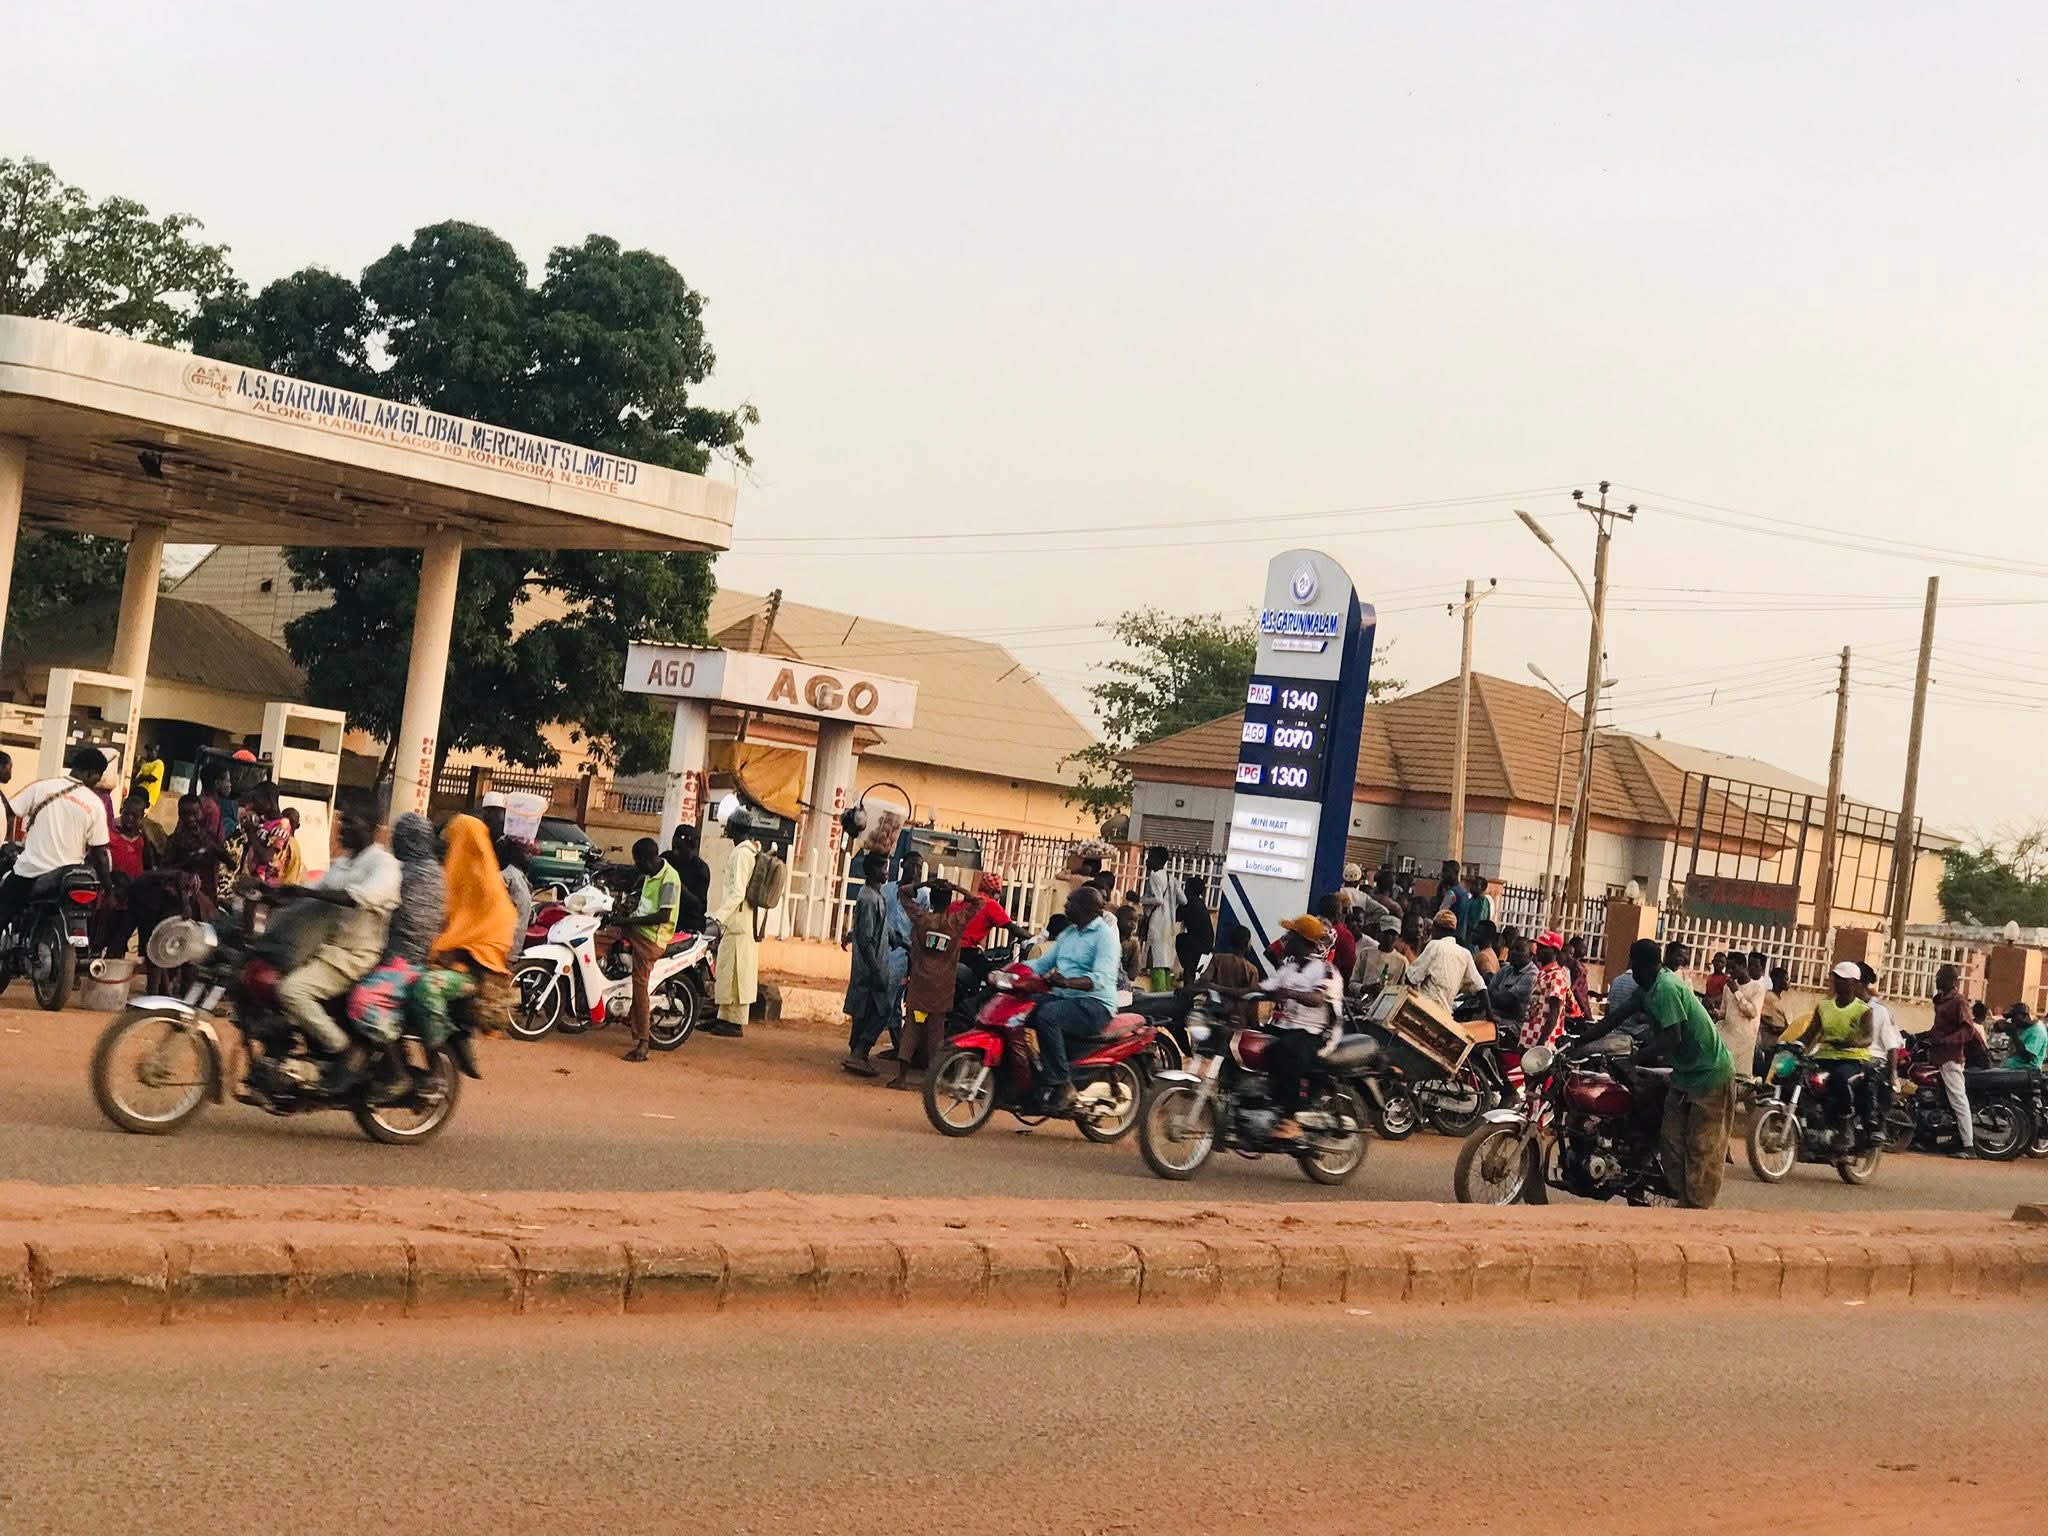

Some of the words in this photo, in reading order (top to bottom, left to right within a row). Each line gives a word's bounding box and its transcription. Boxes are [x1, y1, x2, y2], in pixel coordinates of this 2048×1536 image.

[252, 401, 312, 422] ALONG
[318, 415, 386, 439] KADUNA
[390, 431, 440, 452] LAGOS
[467, 450, 555, 480] KONTAGORA
[337, 394, 399, 429] MALAM
[401, 408, 468, 447] GLOBAL
[472, 425, 571, 470] MERCHANTS
[573, 451, 638, 486] LIMITED
[647, 659, 696, 688] AGO
[766, 667, 879, 716] AGO
[1250, 686, 1270, 702] PMS
[1281, 689, 1319, 711] 1340
[421, 737, 434, 756] NO
[1244, 725, 1265, 741] AGO
[1274, 727, 1313, 750] 2070
[414, 758, 431, 816] SMOKIN
[1238, 765, 1259, 781] LPG
[1270, 765, 1308, 788] 1300
[1250, 817, 1269, 828] MINI
[1269, 819, 1288, 831] MART
[1245, 859, 1282, 873] Lubrication
